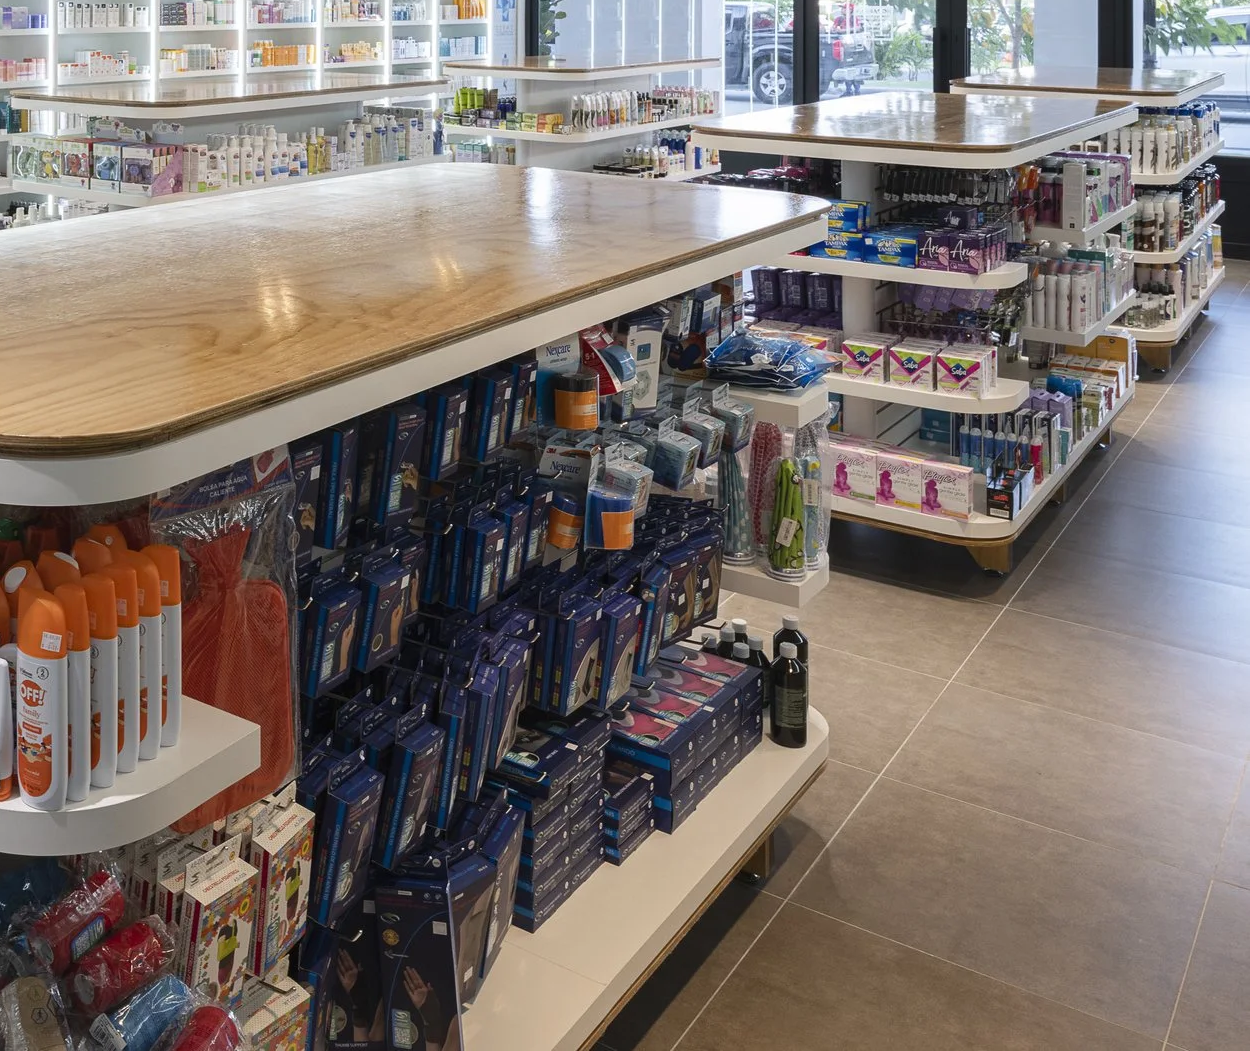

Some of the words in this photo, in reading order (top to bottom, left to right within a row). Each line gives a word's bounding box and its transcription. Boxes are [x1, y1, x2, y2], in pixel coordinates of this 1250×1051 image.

[920, 237, 947, 259] Aria
[950, 240, 978, 261] Aria
[545, 343, 571, 357] Nexcare
[855, 354, 870, 363] Saba
[903, 360, 919, 370] Saba
[951, 367, 967, 376] Saba
[550, 460, 581, 475] Nexcare
[837, 454, 865, 467] Playtex
[878, 460, 910, 476] Playtex
[199, 483, 217, 494] BOLSA
[218, 479, 233, 490] PARA
[231, 475, 248, 486] AGUA
[923, 469, 957, 486] Playtex
[209, 486, 236, 498] CALIENTE
[20, 683, 46, 706] OFF!
[22, 706, 41, 720] family
